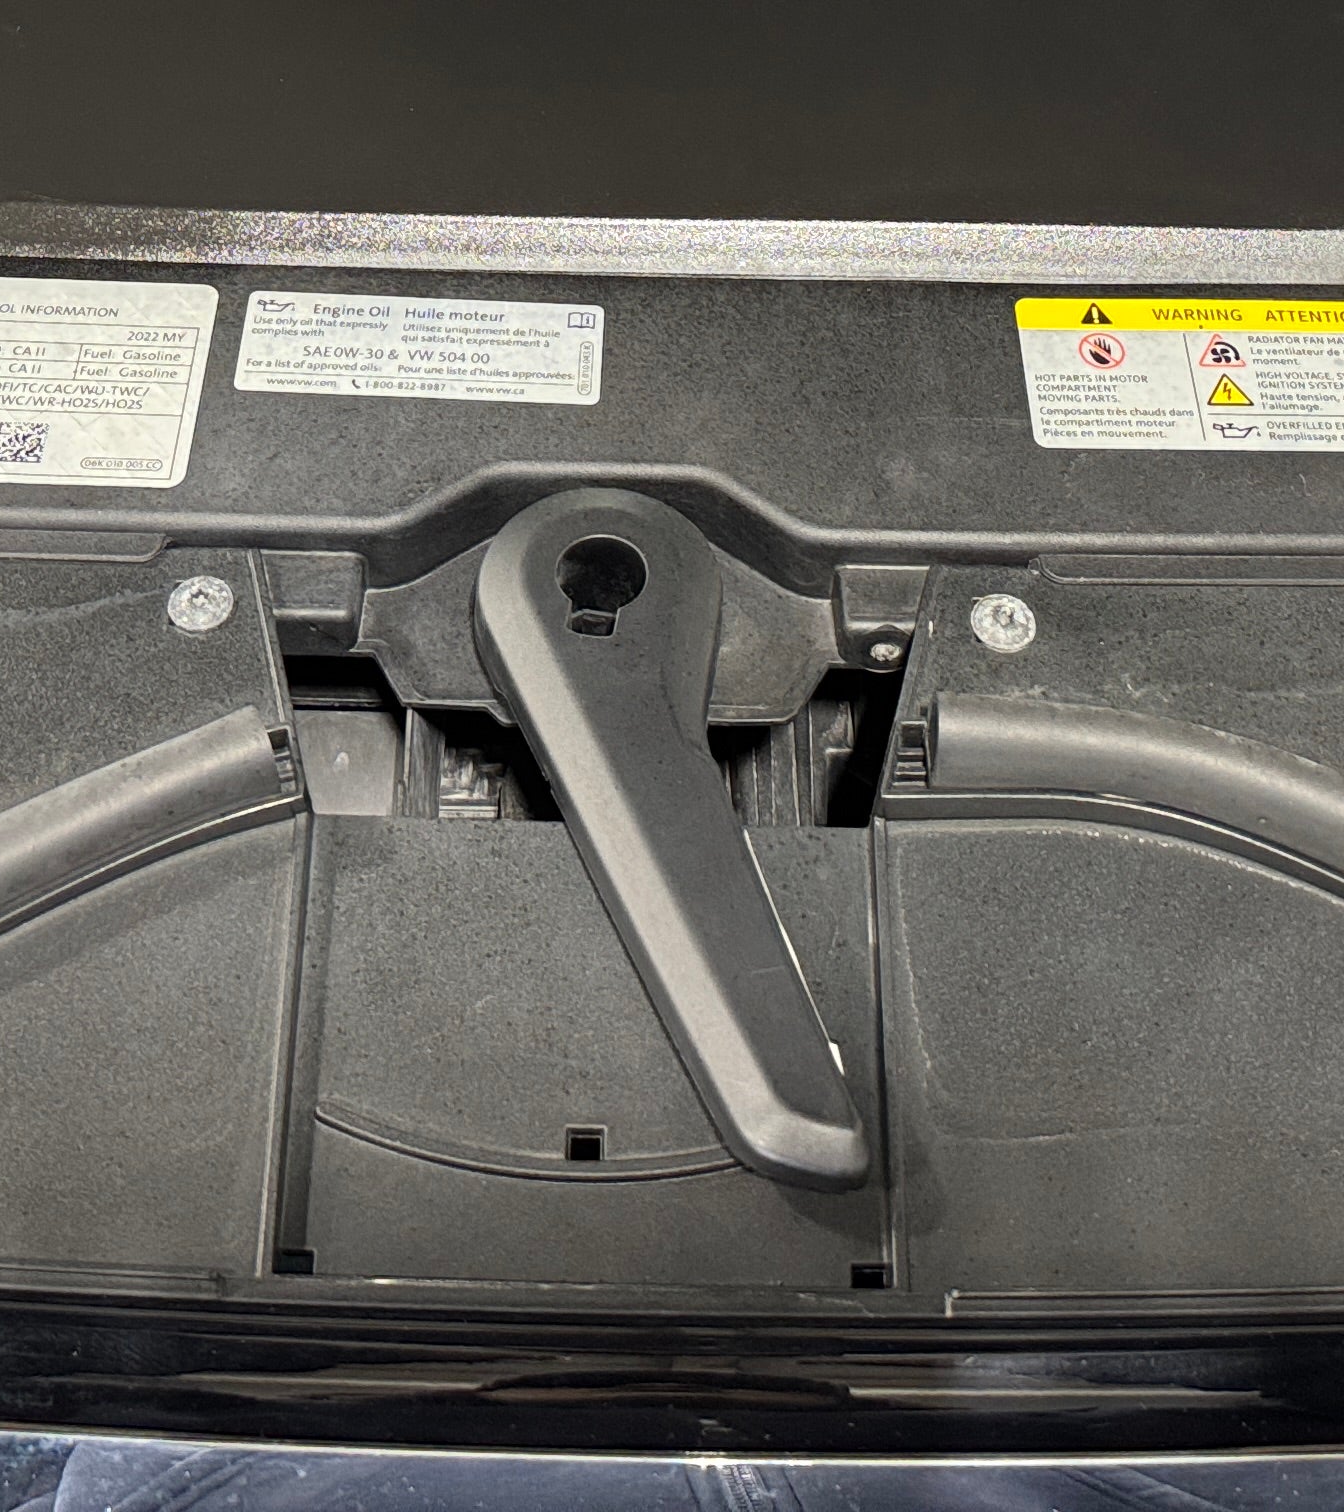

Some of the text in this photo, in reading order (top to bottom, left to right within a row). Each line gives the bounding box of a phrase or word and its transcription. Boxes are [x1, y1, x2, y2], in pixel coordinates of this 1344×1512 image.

[21, 304, 118, 317] INFORMATION
[313, 303, 390, 318] Engine Oil
[404, 307, 504, 322] Huile moteur
[1152, 308, 1242, 321] WARNING
[253, 315, 388, 331] Use only oil that expressly
[126, 330, 186, 342] 2022 MY
[251, 327, 324, 337] complies with
[1247, 335, 1300, 344] RADIATOR
[1302, 336, 1324, 344] FAN
[12, 345, 31, 356] CA
[122, 349, 181, 361] Gasoline
[303, 345, 332, 357] SAE
[387, 348, 399, 360] &
[407, 349, 434, 361] VW
[438, 351, 466, 362] 504
[470, 352, 490, 364] 00
[8, 362, 27, 373] CA
[246, 357, 263, 366] For
[274, 359, 291, 368] list
[292, 359, 306, 368] of
[306, 362, 358, 371] approved
[118, 367, 177, 378] Gasoline
[1254, 371, 1283, 380] HIGH
[1034, 374, 1148, 383] HOT PARTS IN MOTOR
[1257, 380, 1305, 389] IGNITION
[1037, 394, 1081, 402] MOVING
[1266, 421, 1332, 430] OVERFILLED
